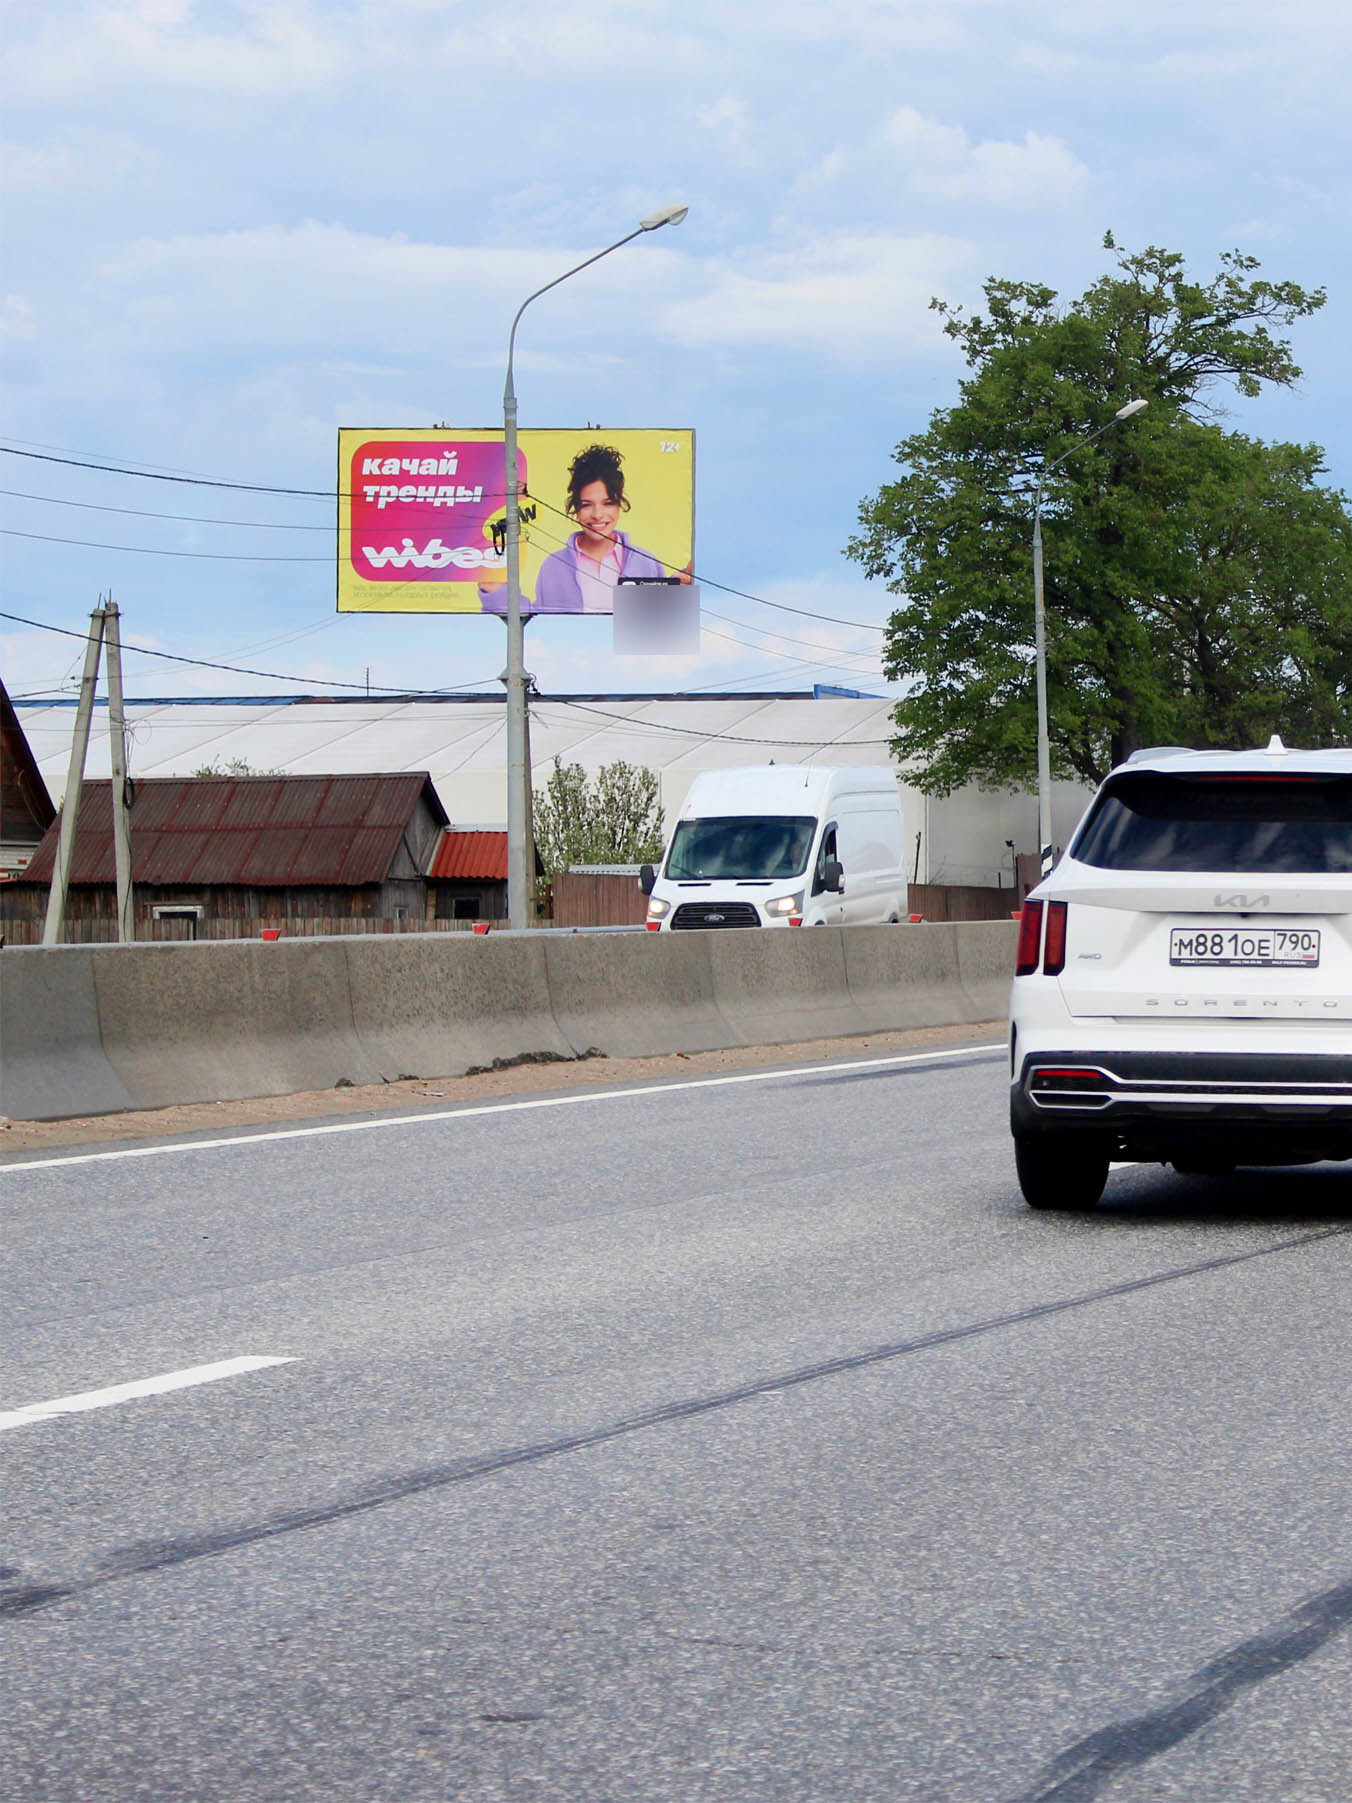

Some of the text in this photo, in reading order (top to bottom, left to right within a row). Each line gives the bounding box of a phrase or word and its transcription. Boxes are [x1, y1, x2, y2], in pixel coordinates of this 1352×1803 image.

[361, 450, 459, 476] качай
[362, 485, 484, 510] тренды
[1213, 894, 1270, 908] KIA
[1276, 932, 1312, 951] 790
[1146, 998, 1338, 1008] SORENTO
